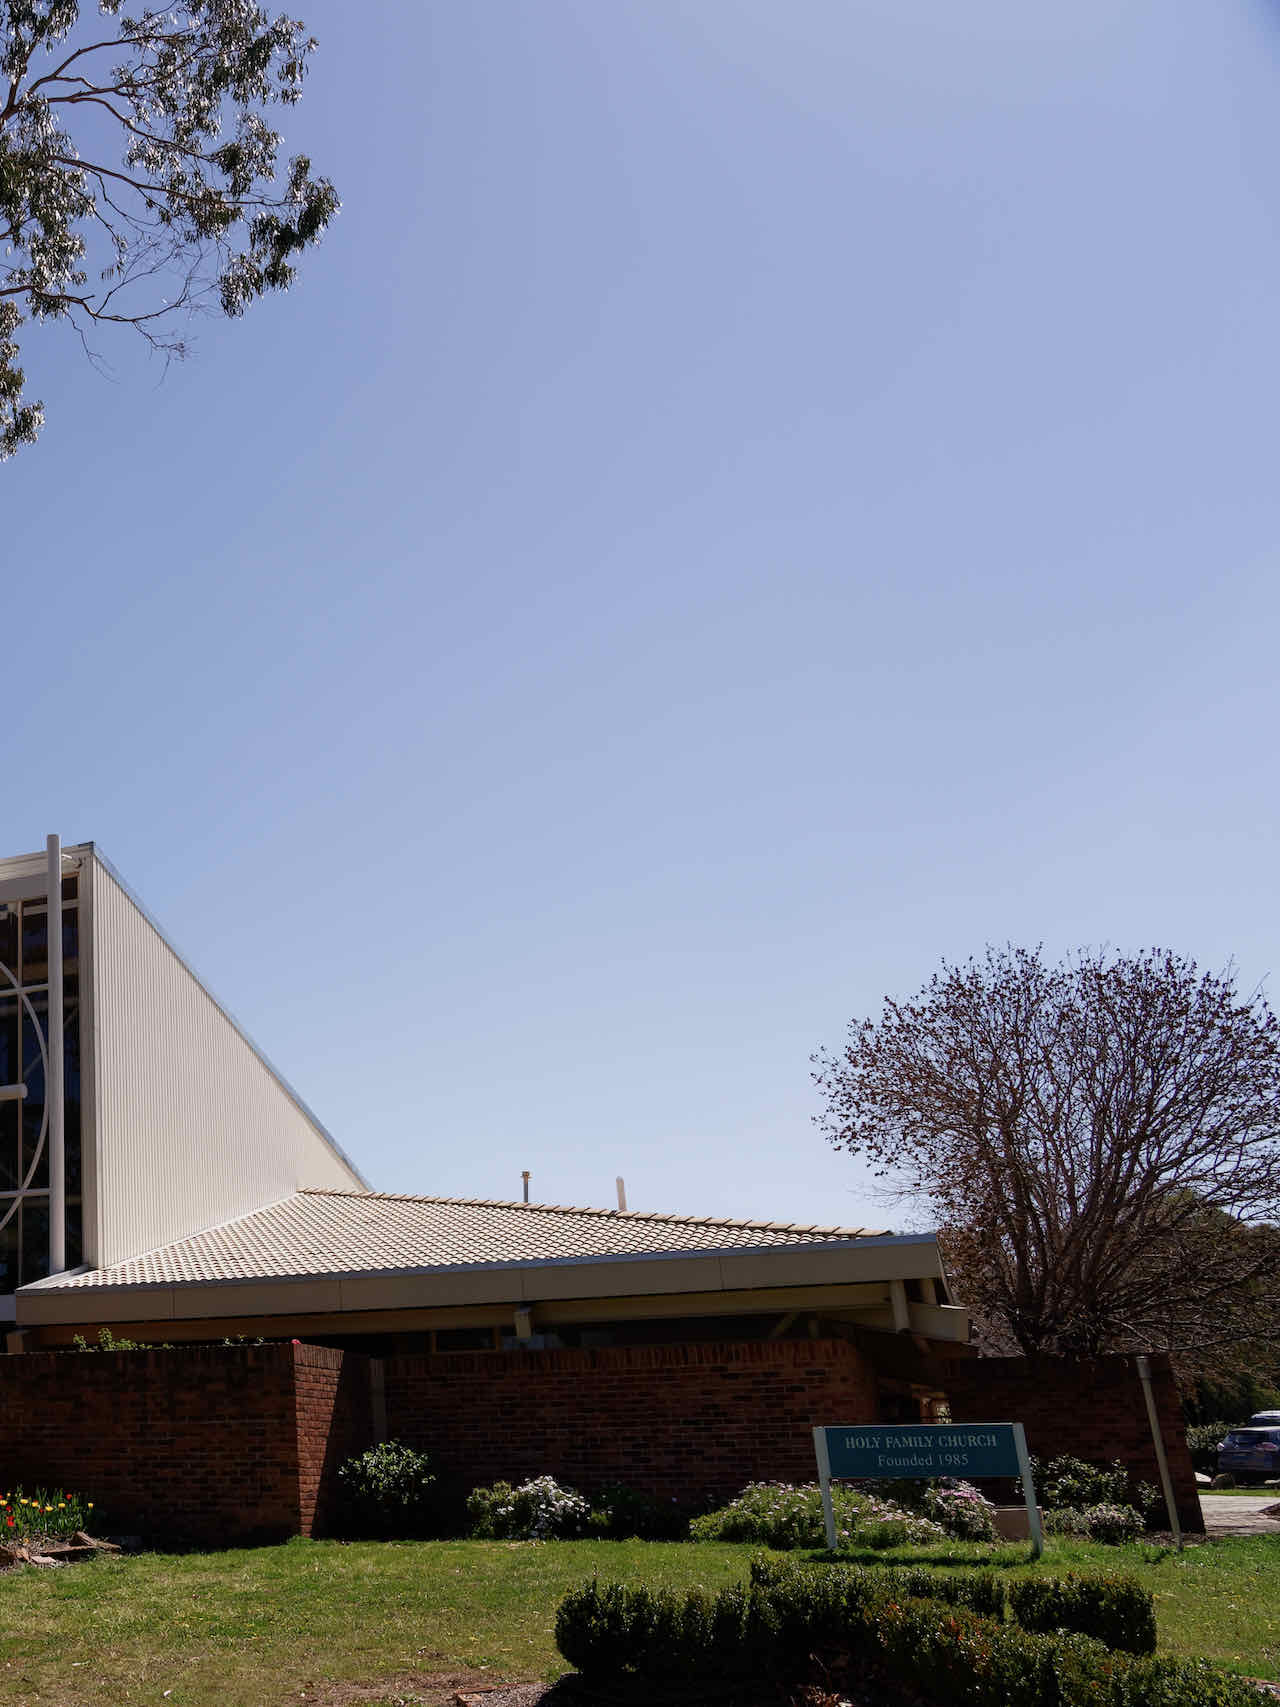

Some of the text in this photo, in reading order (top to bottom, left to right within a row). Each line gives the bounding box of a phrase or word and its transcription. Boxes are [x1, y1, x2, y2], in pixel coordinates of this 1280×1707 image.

[845, 1434, 997, 1449] HOLY FAMILY CHURCH
[878, 1453, 969, 1466] Founded 1985
